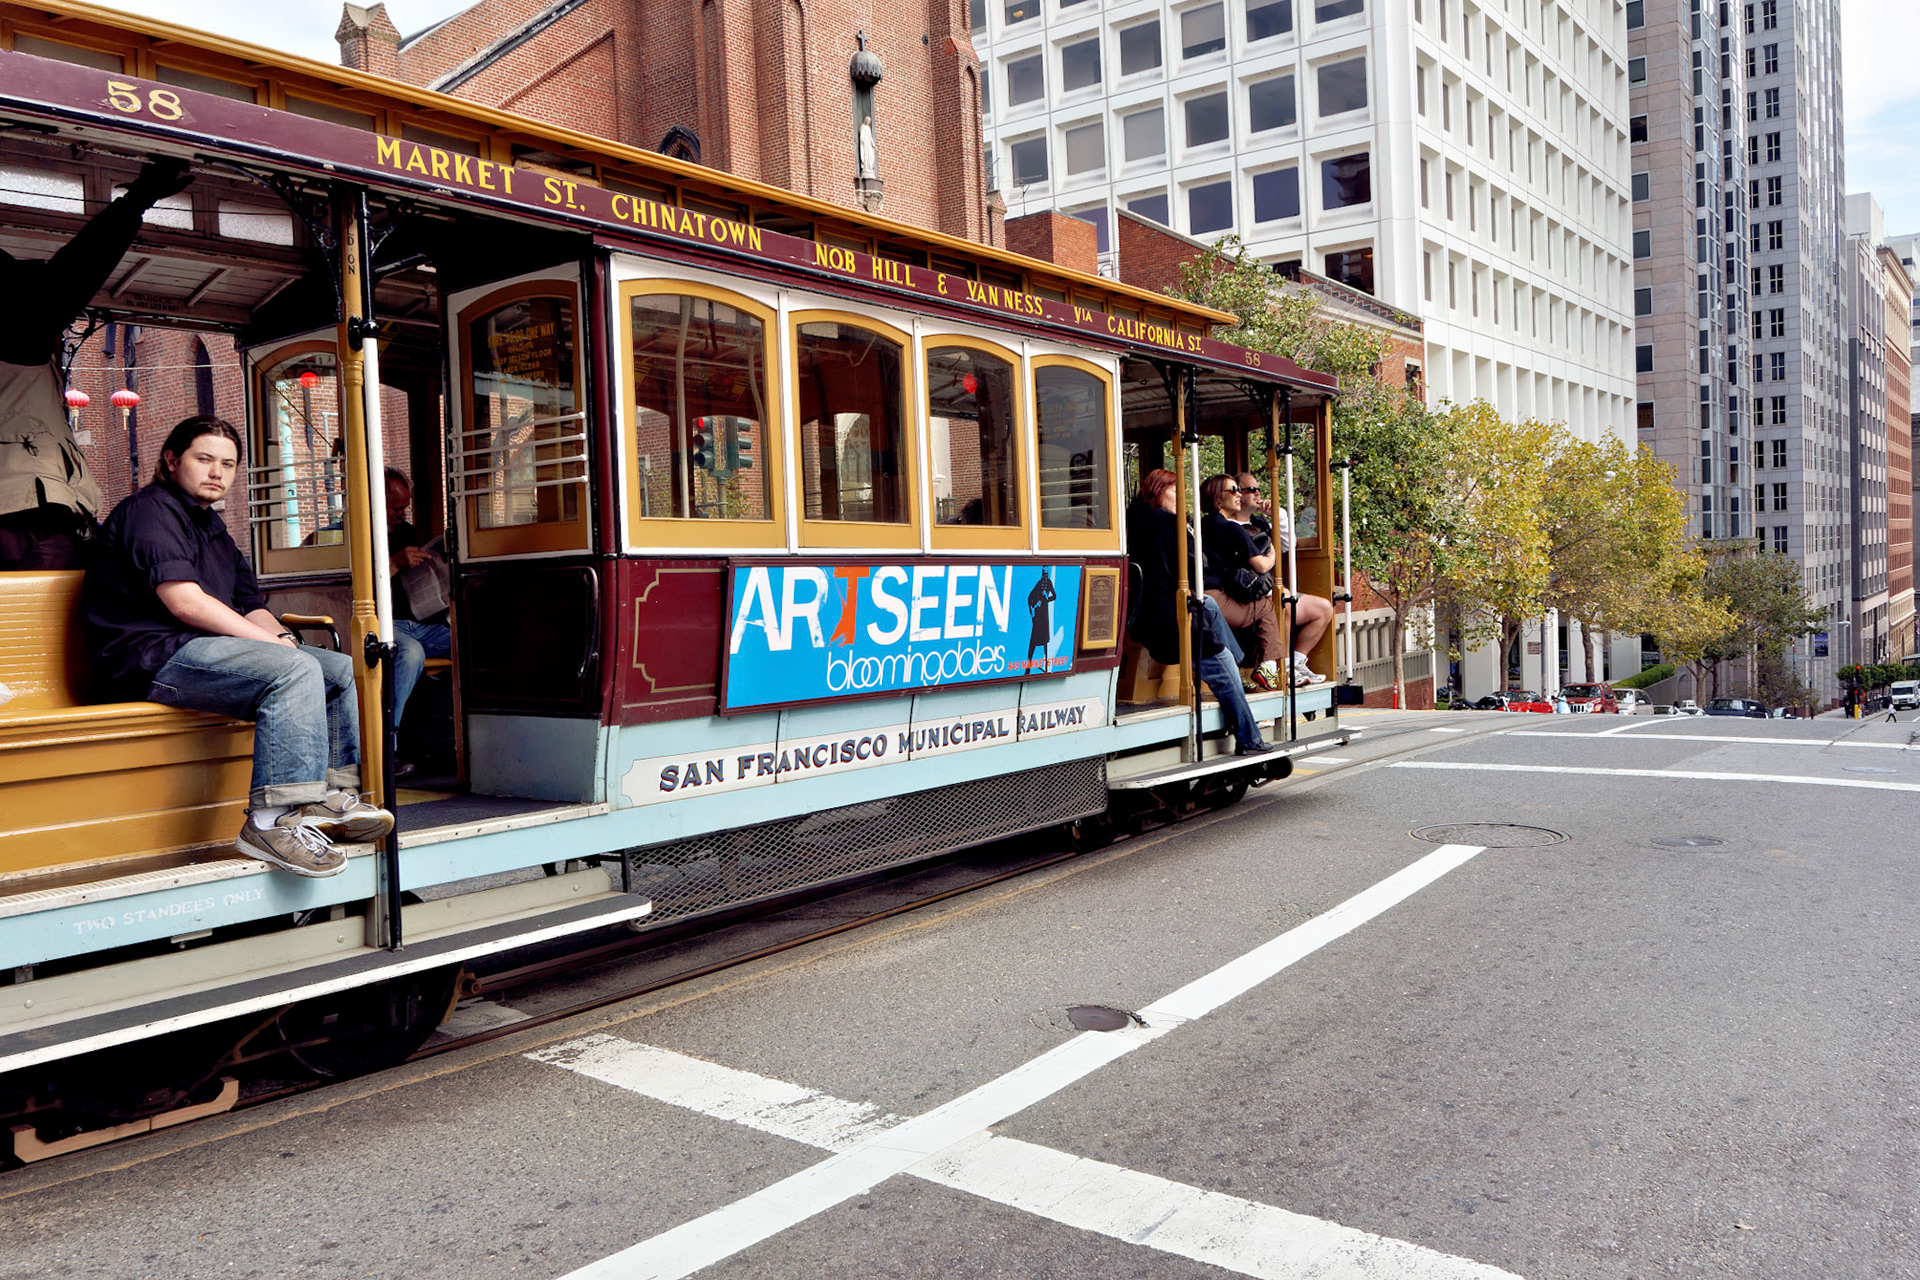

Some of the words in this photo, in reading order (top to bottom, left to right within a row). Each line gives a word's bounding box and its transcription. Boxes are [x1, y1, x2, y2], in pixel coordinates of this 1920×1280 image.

[107, 79, 183, 121] 58
[376, 135, 515, 194] MARKET
[611, 194, 762, 252] CHINATOWN
[815, 243, 856, 274] NOB
[872, 256, 915, 288] HILL
[937, 273, 948, 296] &
[966, 280, 998, 308] VAN
[1004, 289, 1043, 316] NESS
[1074, 306, 1093, 324] VIA
[1107, 315, 1185, 350] CALIFORNIA
[347, 253, 356, 275] ON
[526, 325, 539, 341] ONE
[540, 322, 555, 337] WAY
[531, 348, 552, 359] FLOOR
[1245, 352, 1261, 367] 58
[503, 364, 519, 375] AREA
[520, 361, 541, 371] CLEAR
[1021, 658, 1046, 669] MARKET
[1047, 656, 1069, 667] STREET
[659, 758, 725, 793] SAN
[737, 733, 888, 780] FRANCISCO
[898, 717, 1010, 754] MUNICIPAL
[1016, 705, 1087, 735] RAILWAY
[73, 915, 115, 935] TWO
[122, 897, 216, 927] STANDEES
[222, 886, 265, 907] ONLY
